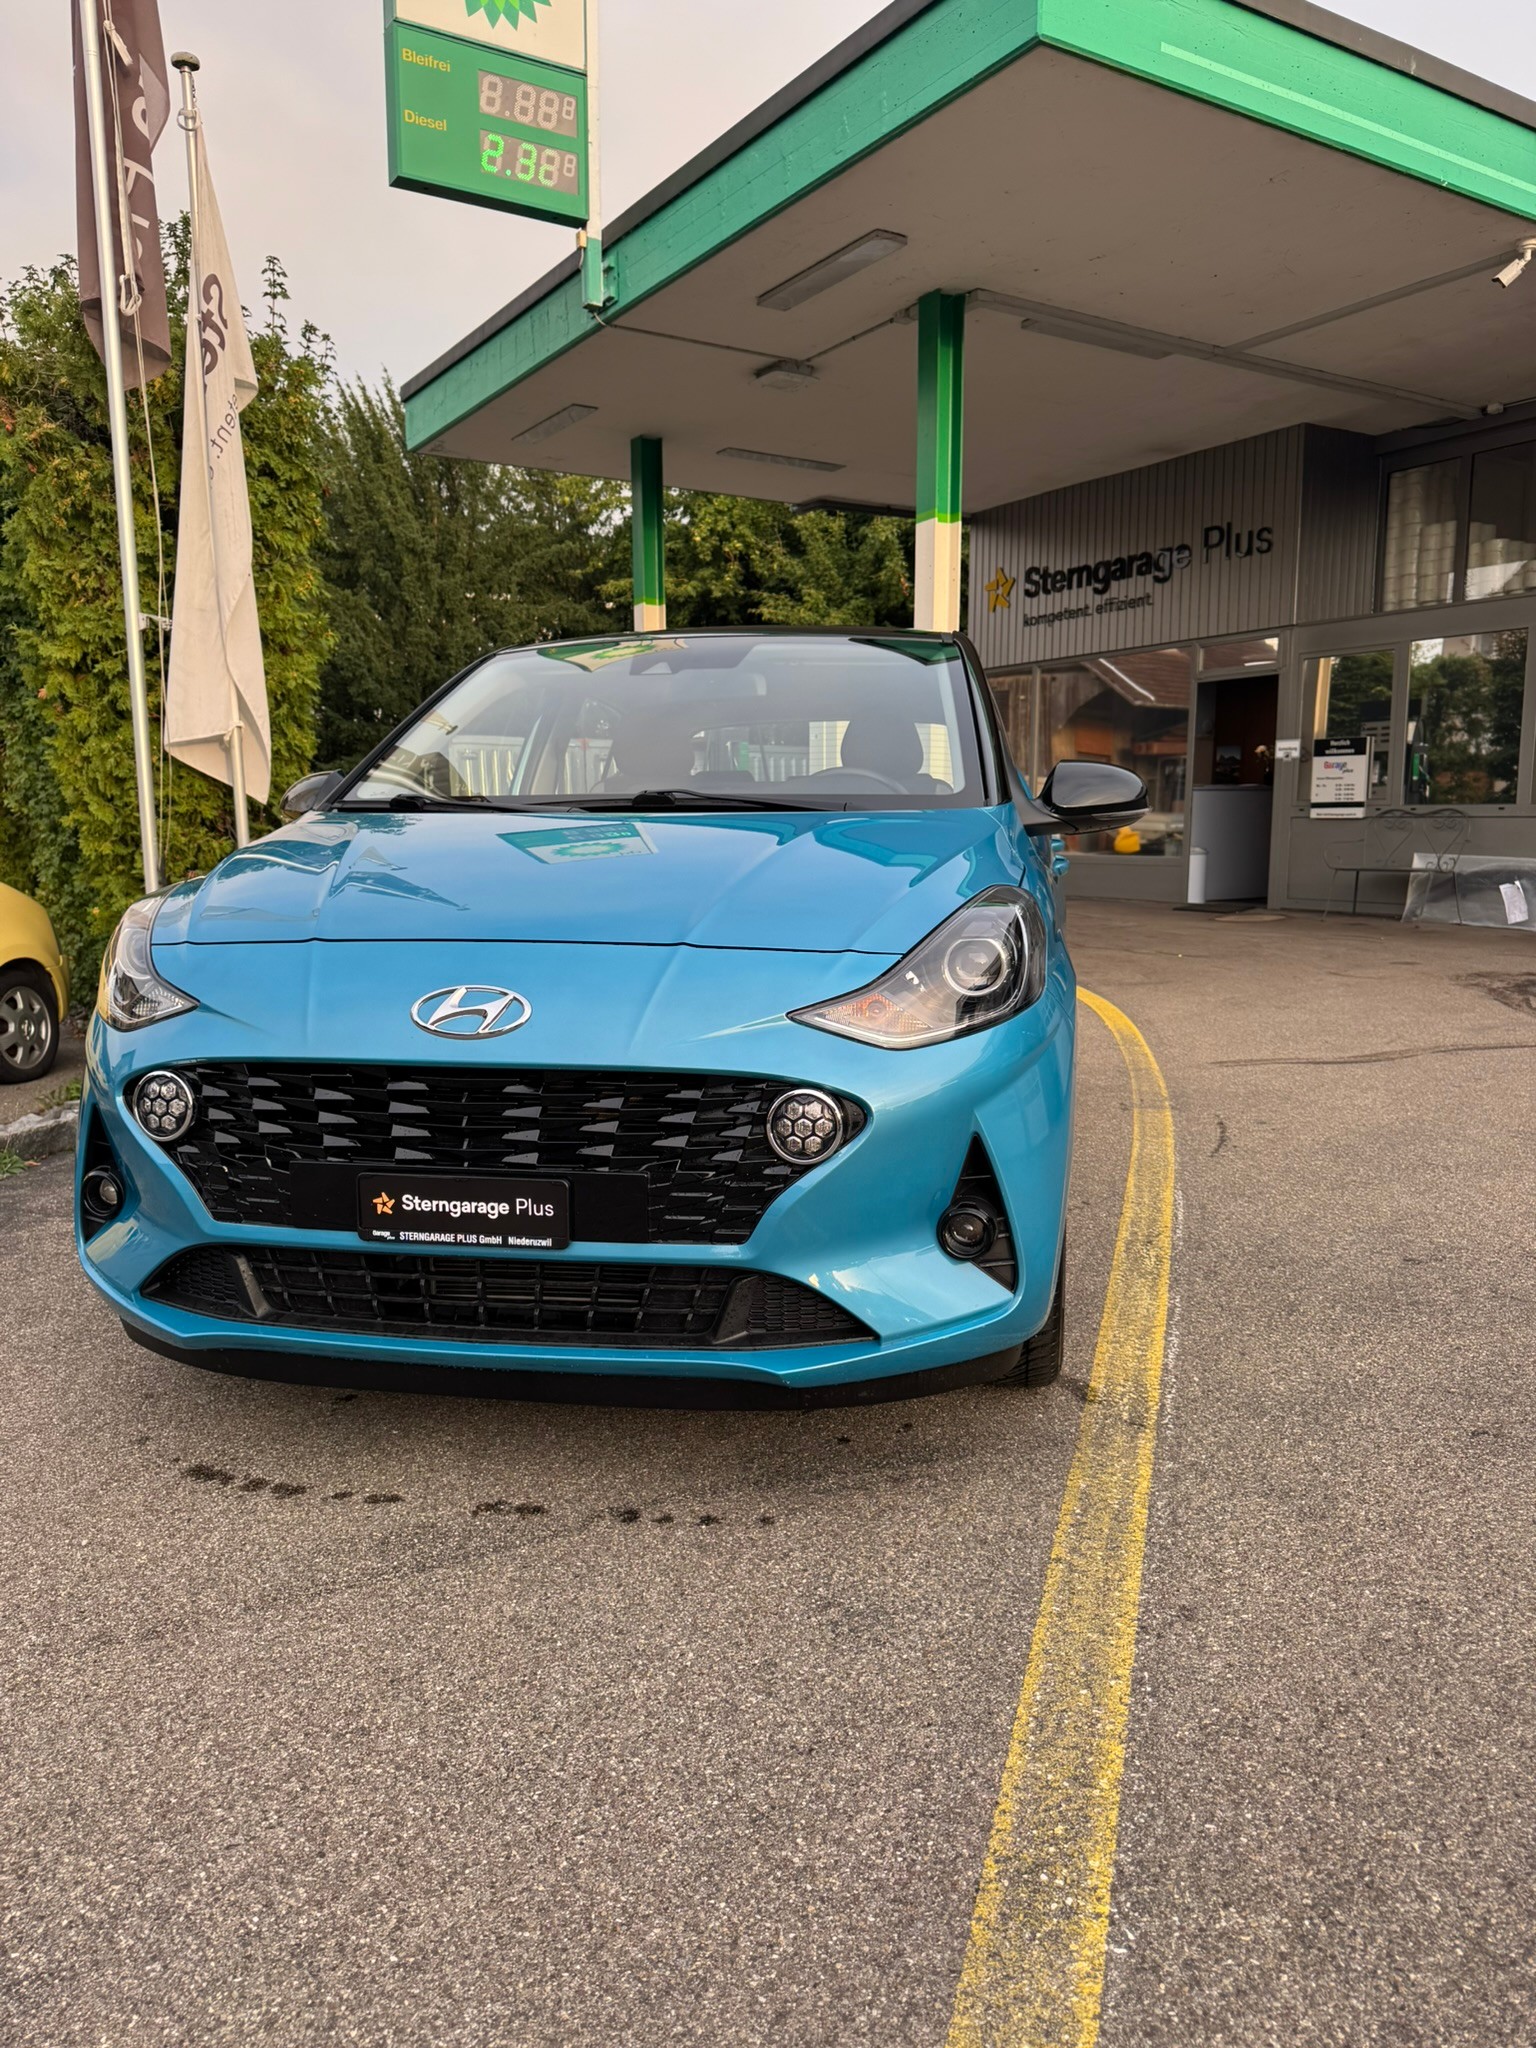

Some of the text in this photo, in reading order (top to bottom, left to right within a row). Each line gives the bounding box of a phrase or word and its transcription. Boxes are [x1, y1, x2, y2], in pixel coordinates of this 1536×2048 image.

[402, 48, 450, 72] Bleifrei
[404, 109, 447, 131] Diesel
[1023, 521, 1273, 599] Sterngarage Plus
[401, 1194, 555, 1220] Sterngarage Plus
[399, 1231, 553, 1248] STERNGARAGE PLUS GmbH Niederuzwil
